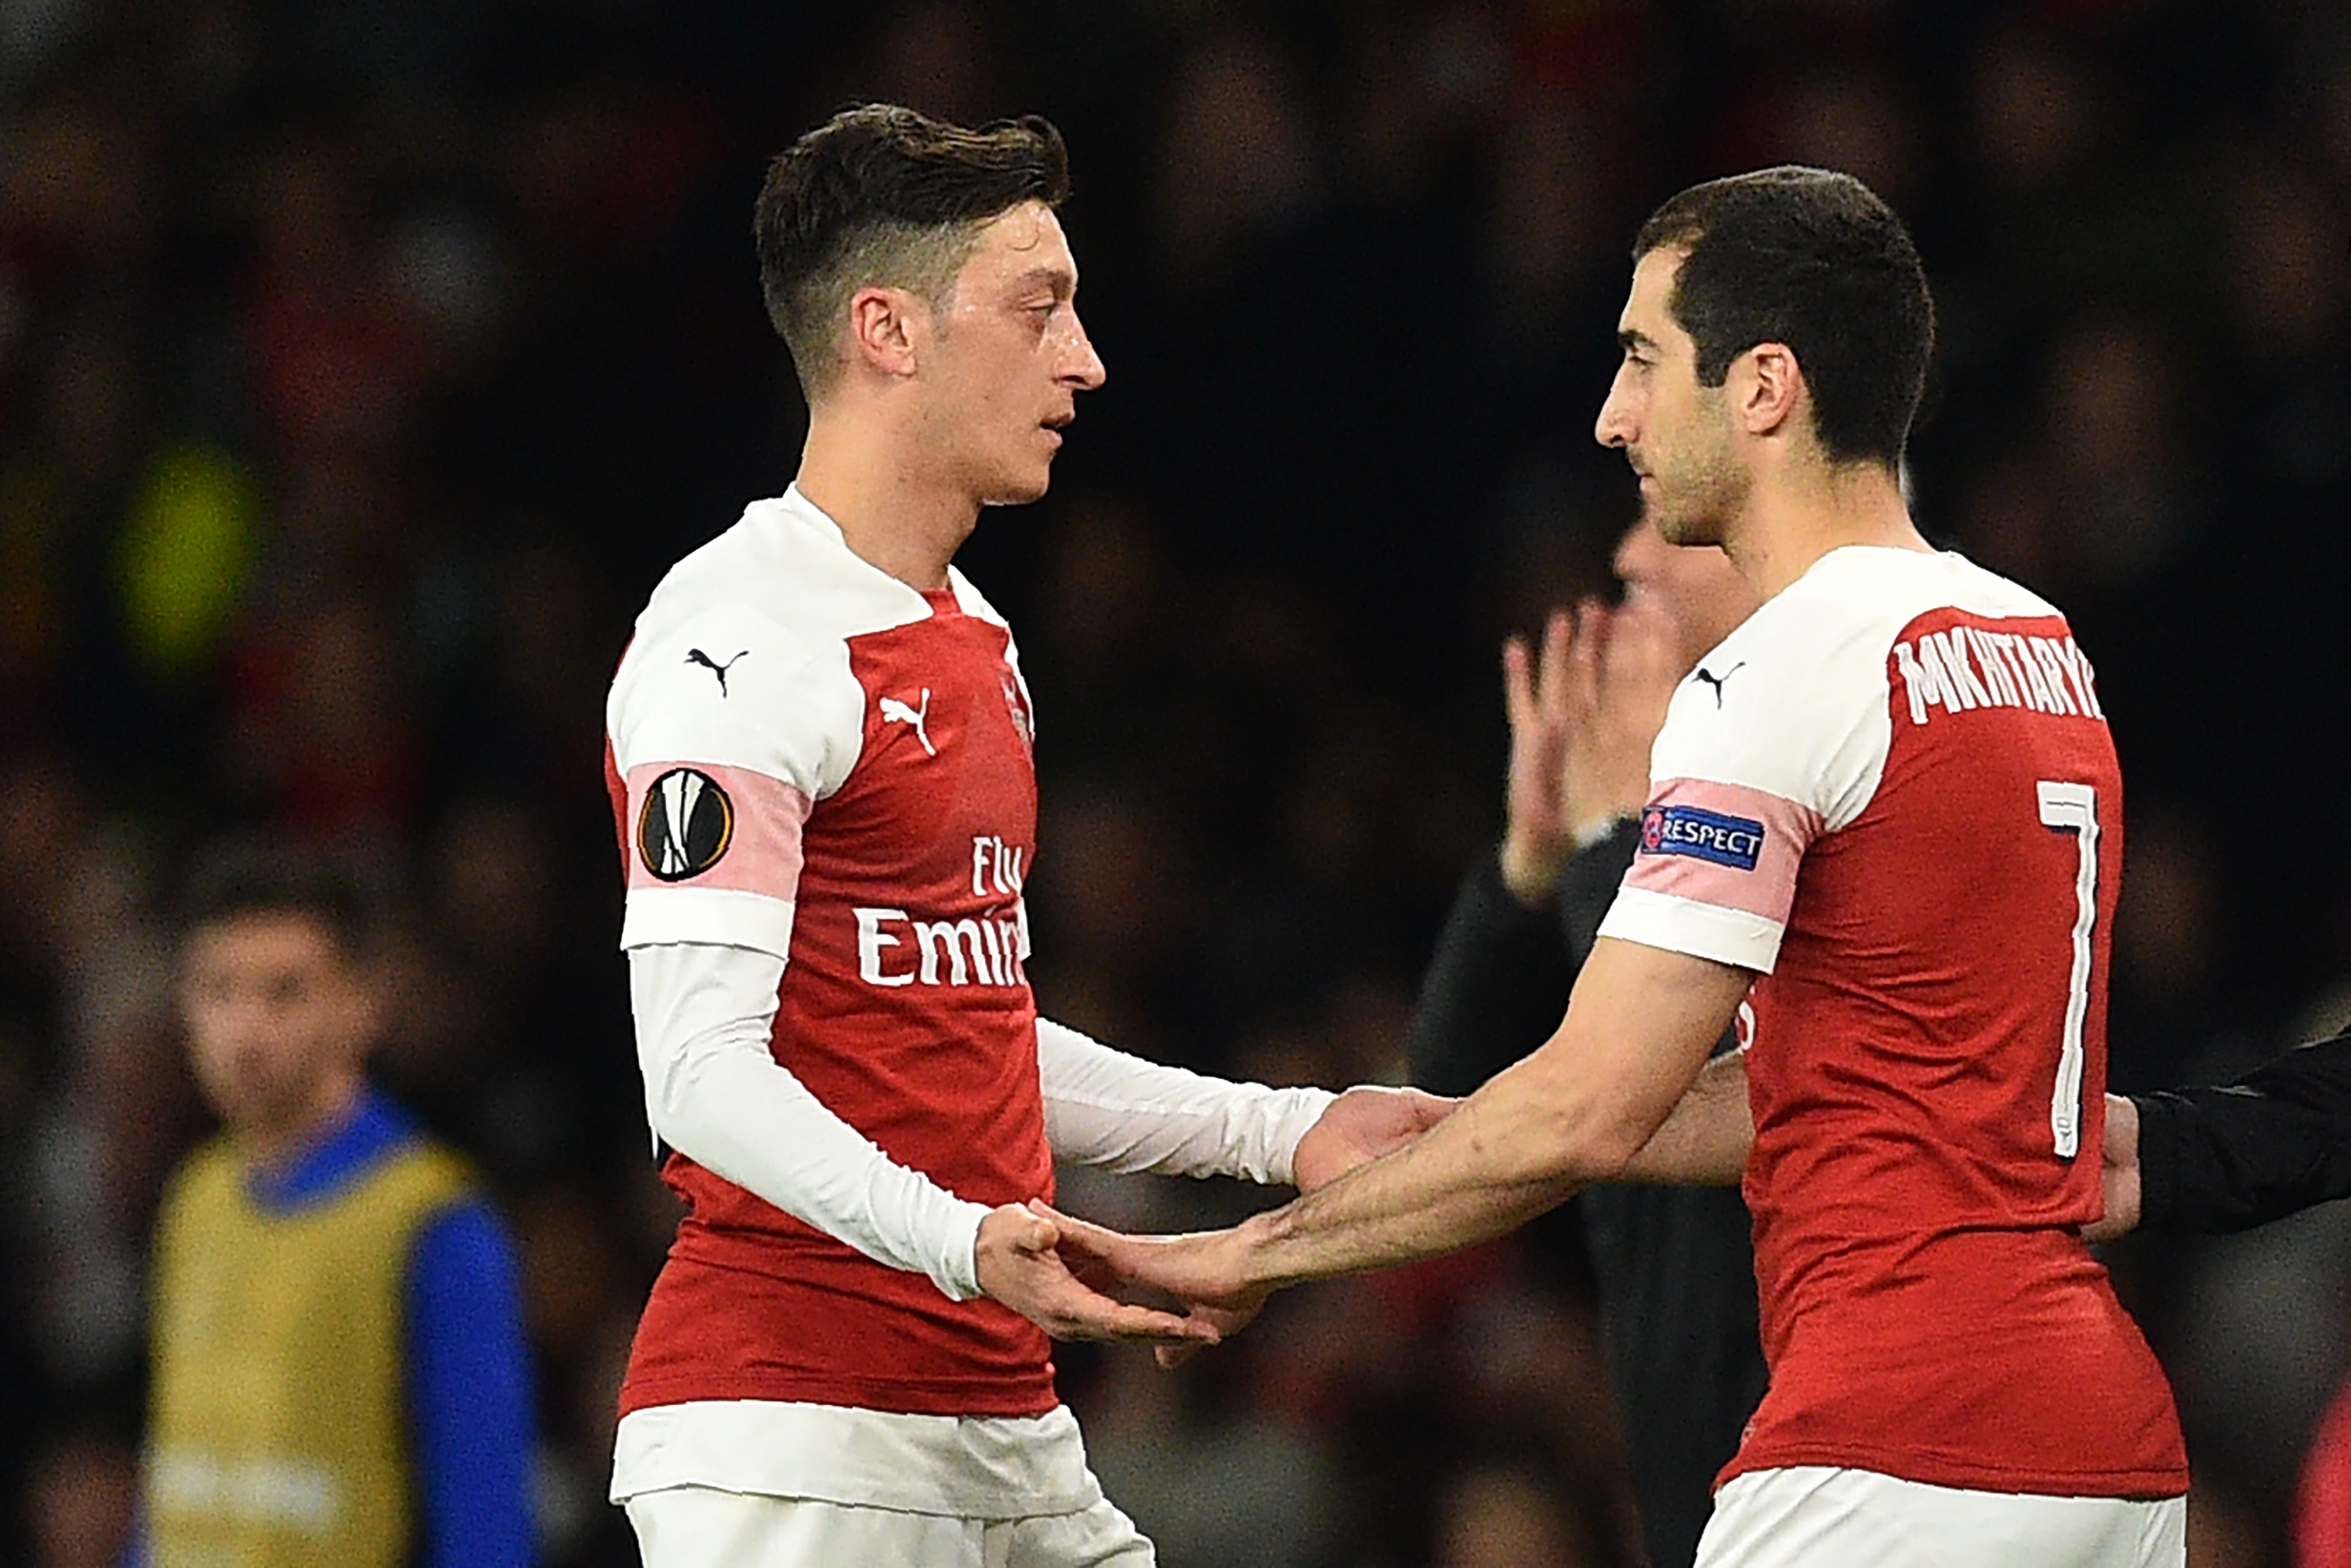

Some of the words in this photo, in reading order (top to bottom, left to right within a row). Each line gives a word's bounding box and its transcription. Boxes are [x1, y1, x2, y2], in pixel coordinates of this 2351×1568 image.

[973, 835, 1022, 896] Fly
[1662, 819, 1761, 856] RESPECT
[852, 904, 1028, 987] Emir
[2037, 780, 2099, 1157] 7
